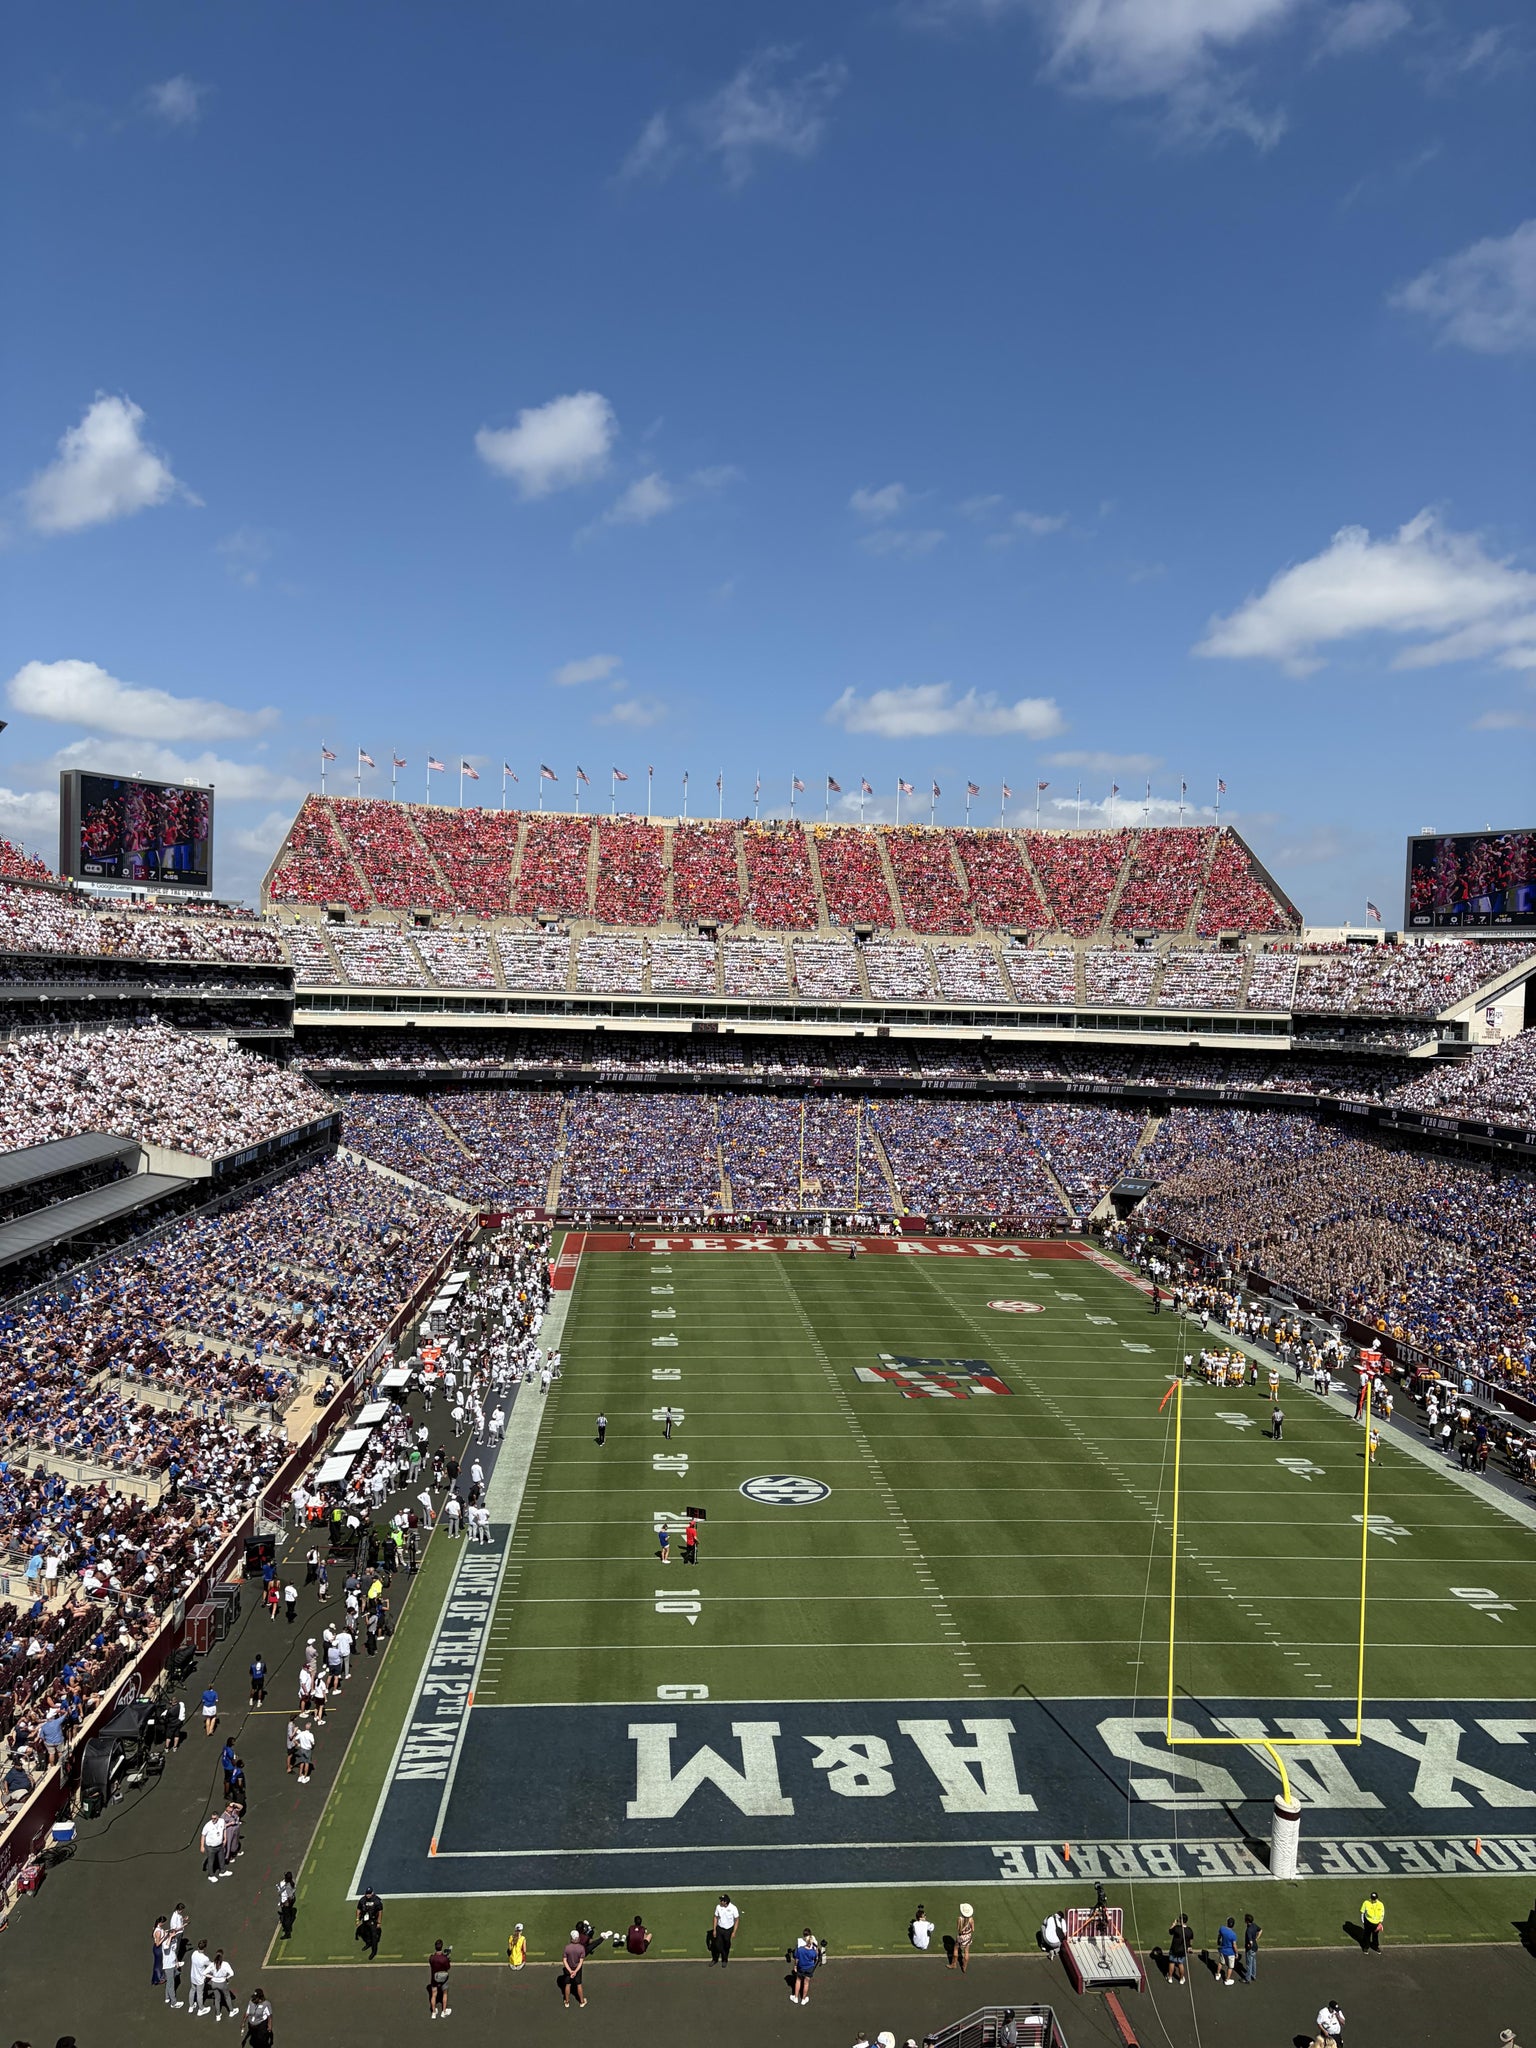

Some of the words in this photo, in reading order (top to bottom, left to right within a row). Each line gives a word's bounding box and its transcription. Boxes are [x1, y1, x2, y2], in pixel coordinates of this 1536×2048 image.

[639, 1238, 867, 1251] TEXAS
[893, 1242, 1031, 1257] A&M
[652, 1368, 681, 1381] 50
[1396, 1343, 1423, 1364] TEXAS
[1448, 1368, 1495, 1403] FOOBALL
[652, 1406, 685, 1421] 40
[1215, 1412, 1257, 1426] 40
[652, 1453, 689, 1471] 30
[1275, 1458, 1326, 1475] 30
[746, 1477, 824, 1503] SEC
[1351, 1514, 1413, 1536] 20
[454, 1553, 502, 1597] HOME
[447, 1600, 490, 1622] OF
[655, 1589, 702, 1613] 10
[1449, 1587, 1518, 1611] 10
[432, 1627, 484, 1667] THE
[422, 1672, 472, 1716] 12TH
[657, 1684, 709, 1700] G
[395, 1722, 460, 1780] MAN
[627, 1719, 1038, 1818] A&M
[991, 1844, 1187, 1879] BRAVE
[1312, 1841, 1388, 1874] OF
